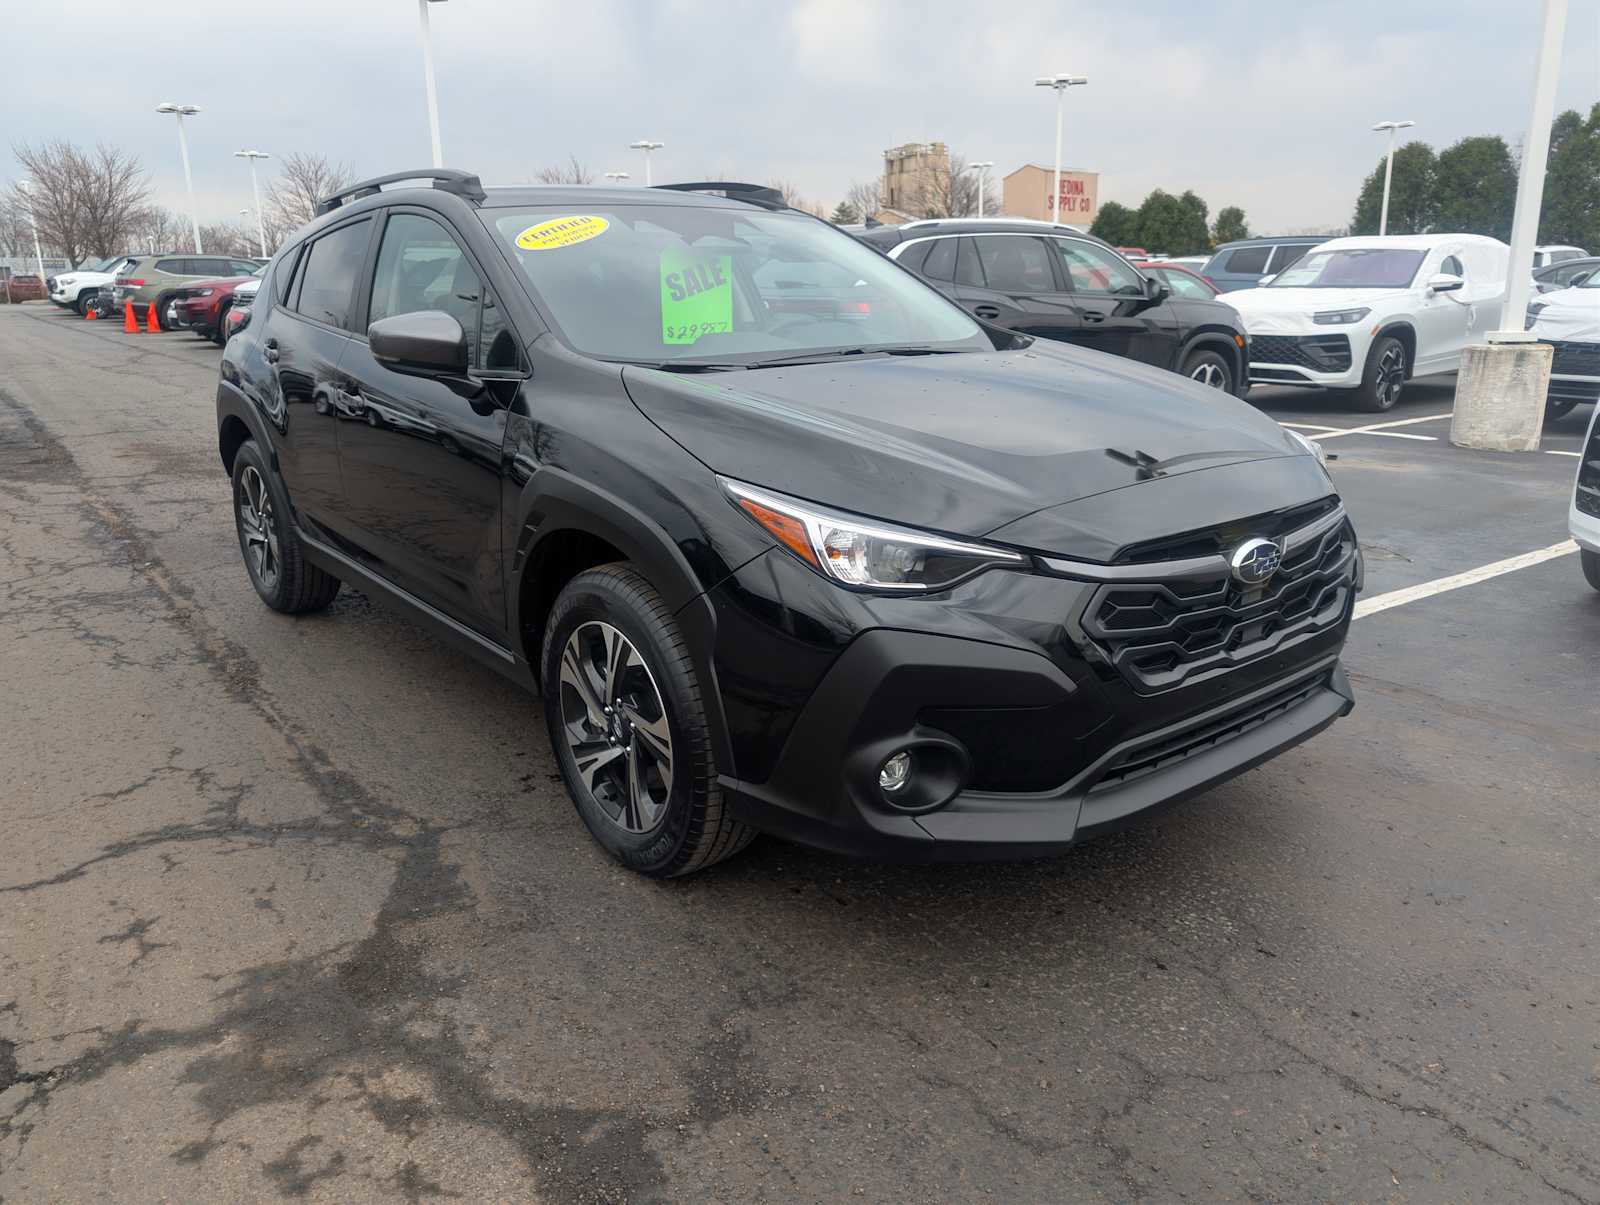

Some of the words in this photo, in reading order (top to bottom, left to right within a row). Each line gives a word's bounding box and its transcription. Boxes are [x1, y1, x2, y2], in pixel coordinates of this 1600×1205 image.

[1059, 179, 1084, 195] EDINA
[1047, 194, 1077, 212] SPPLY
[522, 216, 593, 243] CERTIFIED
[665, 258, 727, 302] SALE
